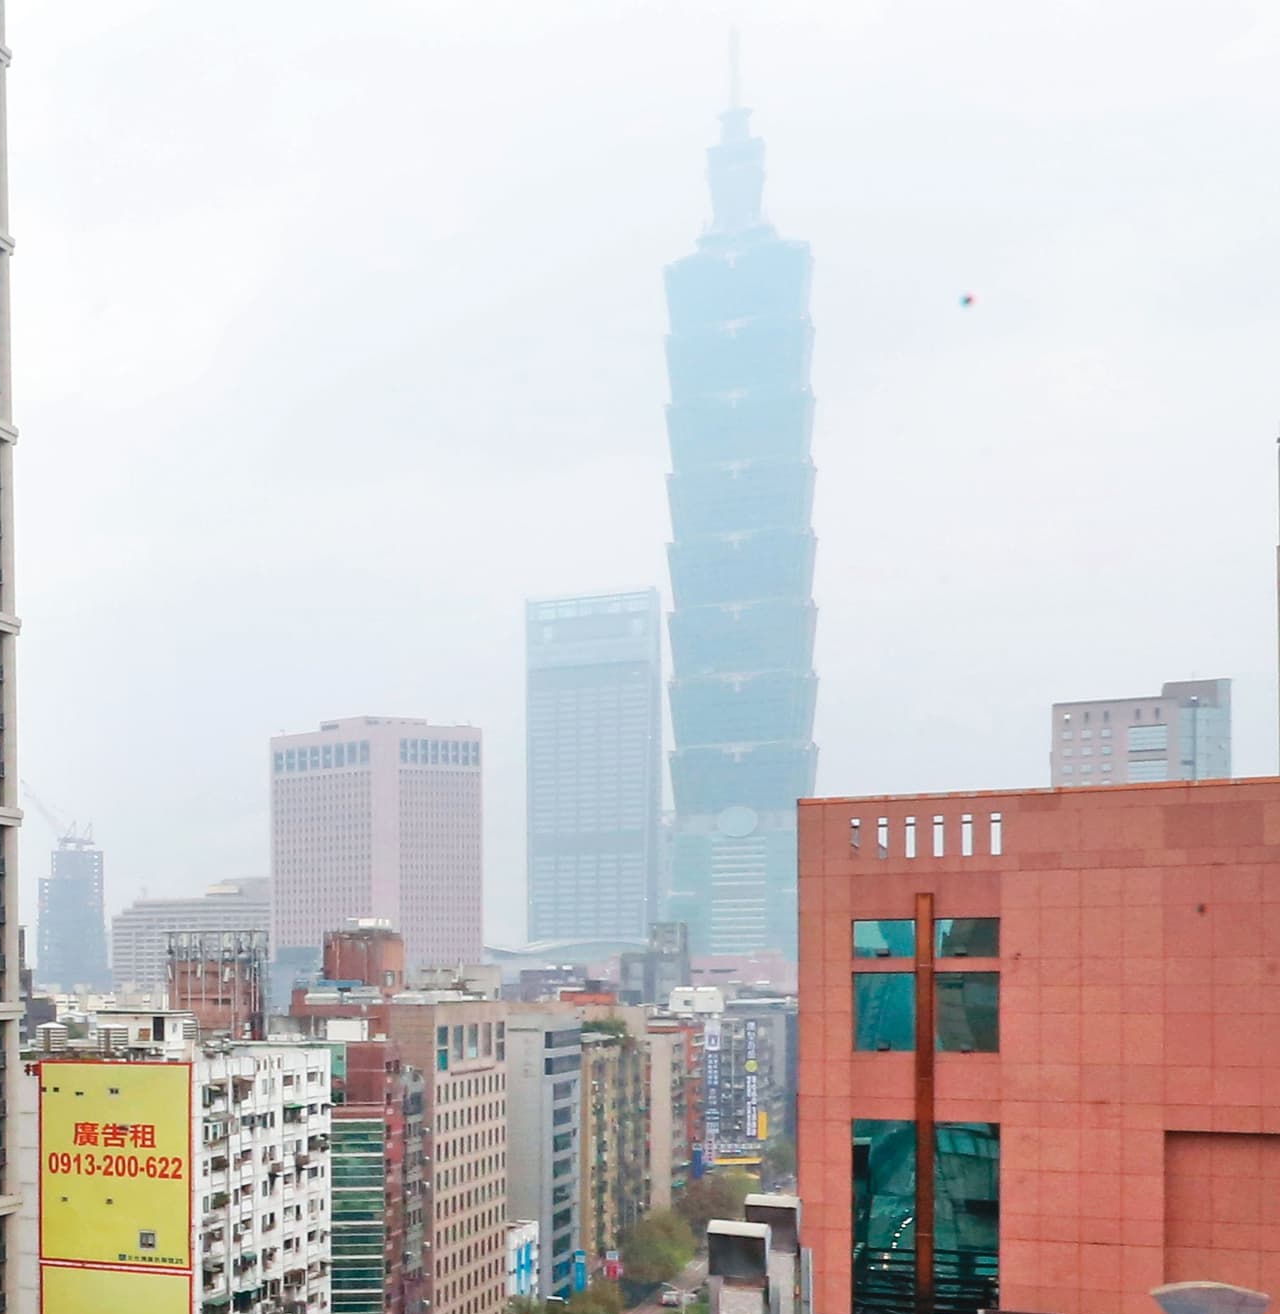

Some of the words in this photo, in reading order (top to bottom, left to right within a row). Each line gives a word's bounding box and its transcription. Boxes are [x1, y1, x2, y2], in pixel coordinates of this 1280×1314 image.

[73, 1122, 157, 1150] 廣告租
[48, 1152, 183, 1181] 0913-200-622
